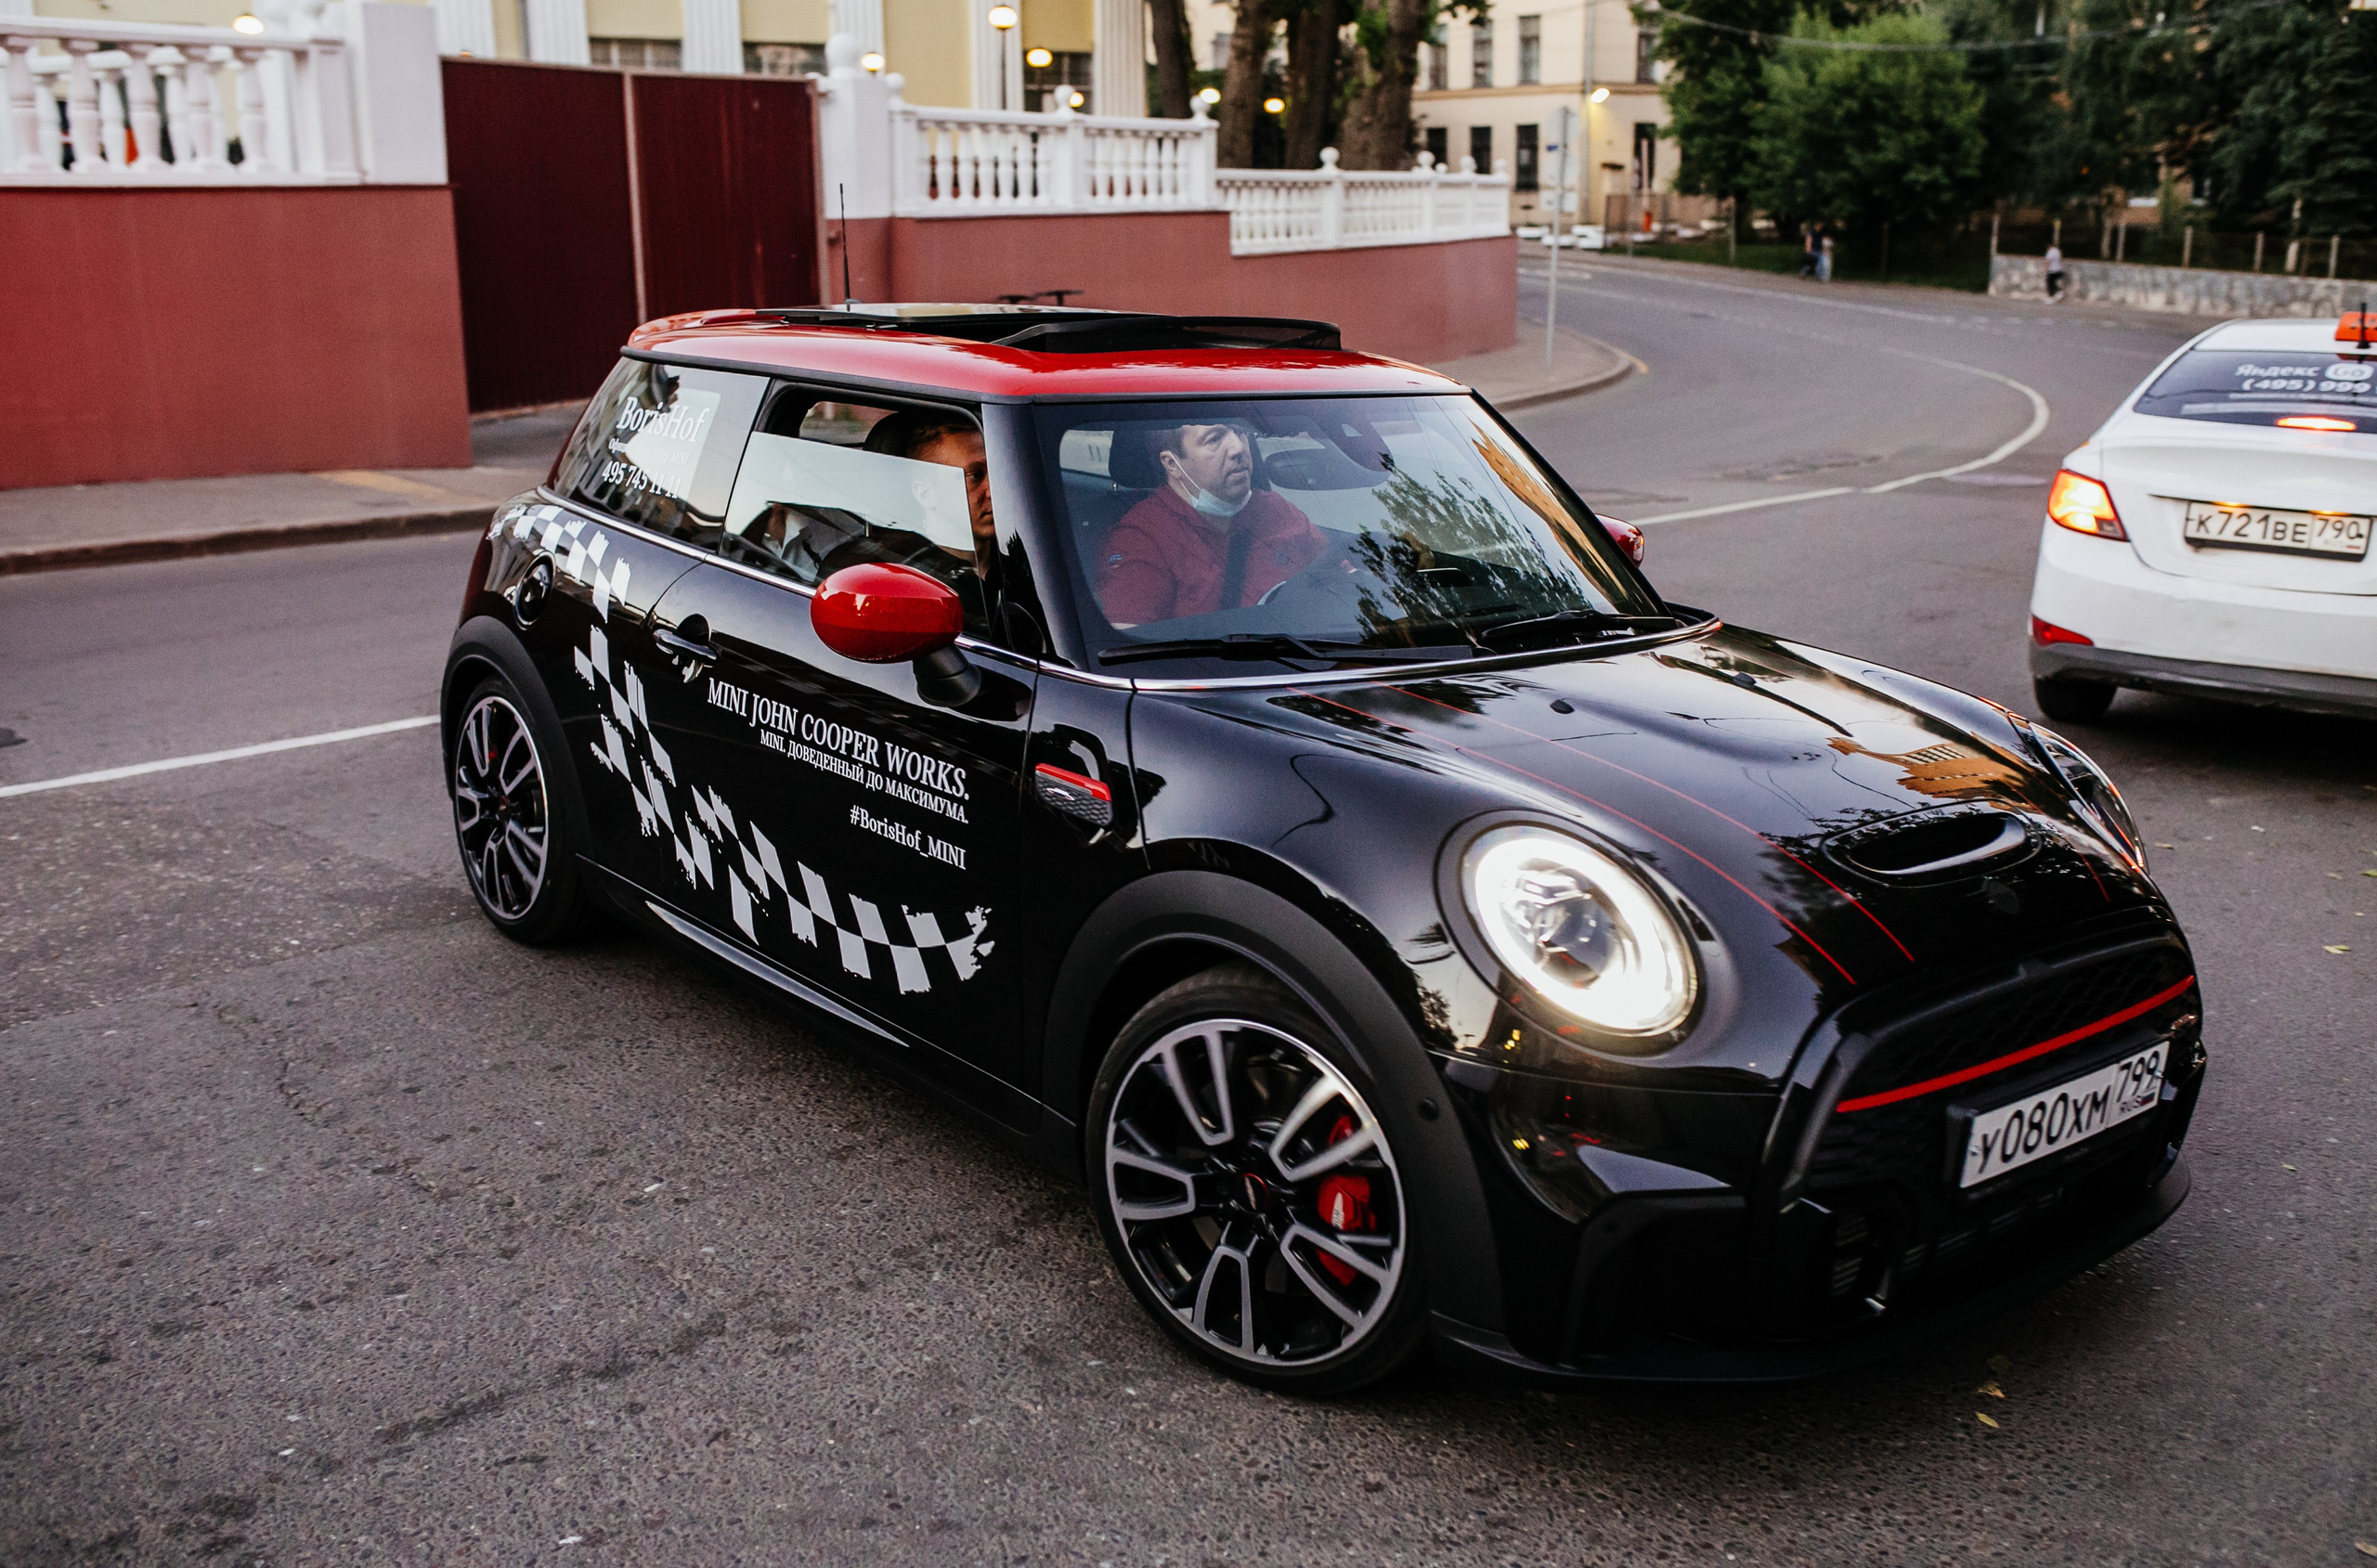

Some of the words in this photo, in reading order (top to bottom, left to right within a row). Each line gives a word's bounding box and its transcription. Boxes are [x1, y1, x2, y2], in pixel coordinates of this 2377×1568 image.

[2235, 364, 2320, 377] Яндекс
[2241, 378, 2316, 392] (495)
[2319, 381, 2371, 394] 999
[617, 396, 710, 443] BorisHof
[602, 460, 627, 486] 495
[625, 465, 649, 490] 745
[649, 471, 666, 495] 11
[665, 475, 682, 499] 11
[2317, 518, 2360, 539] 790
[708, 678, 748, 717] MINI
[749, 693, 799, 735] JOHN
[800, 713, 879, 767] COOPER
[885, 742, 969, 800] WORKS.
[760, 729, 786, 753] MINI.
[787, 740, 864, 784] ДОВЕДЕННЫЙ
[865, 769, 883, 791] ДО
[885, 777, 968, 823] МАКСИМУМА.
[850, 804, 967, 870] #BorisHof_MINI
[2117, 1050, 2161, 1102] 799
